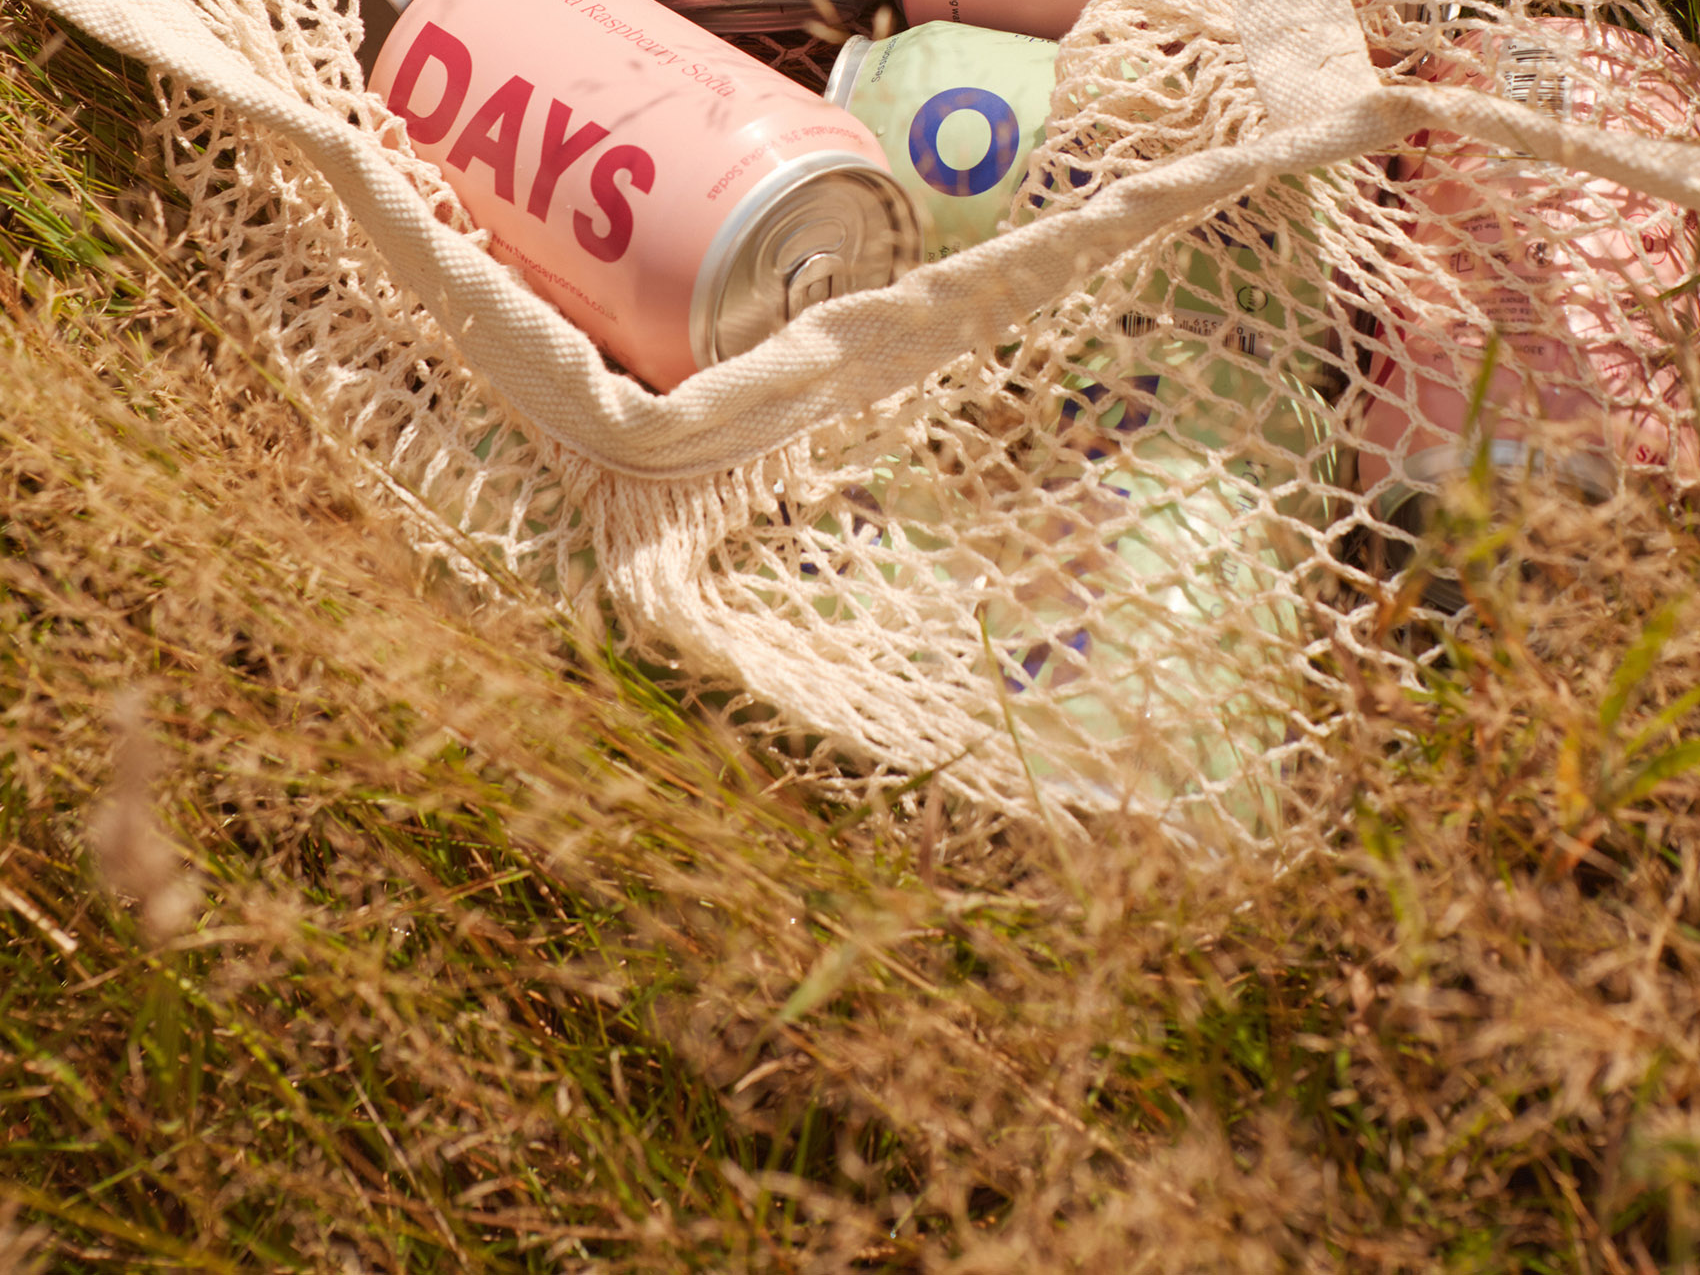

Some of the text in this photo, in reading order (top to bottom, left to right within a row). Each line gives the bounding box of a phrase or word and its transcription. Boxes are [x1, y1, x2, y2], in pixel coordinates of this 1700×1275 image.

[580, 3, 685, 66] Raspberry
[681, 63, 736, 97] Soda
[387, 21, 656, 263] DAYS
[706, 163, 744, 201] Sodas
